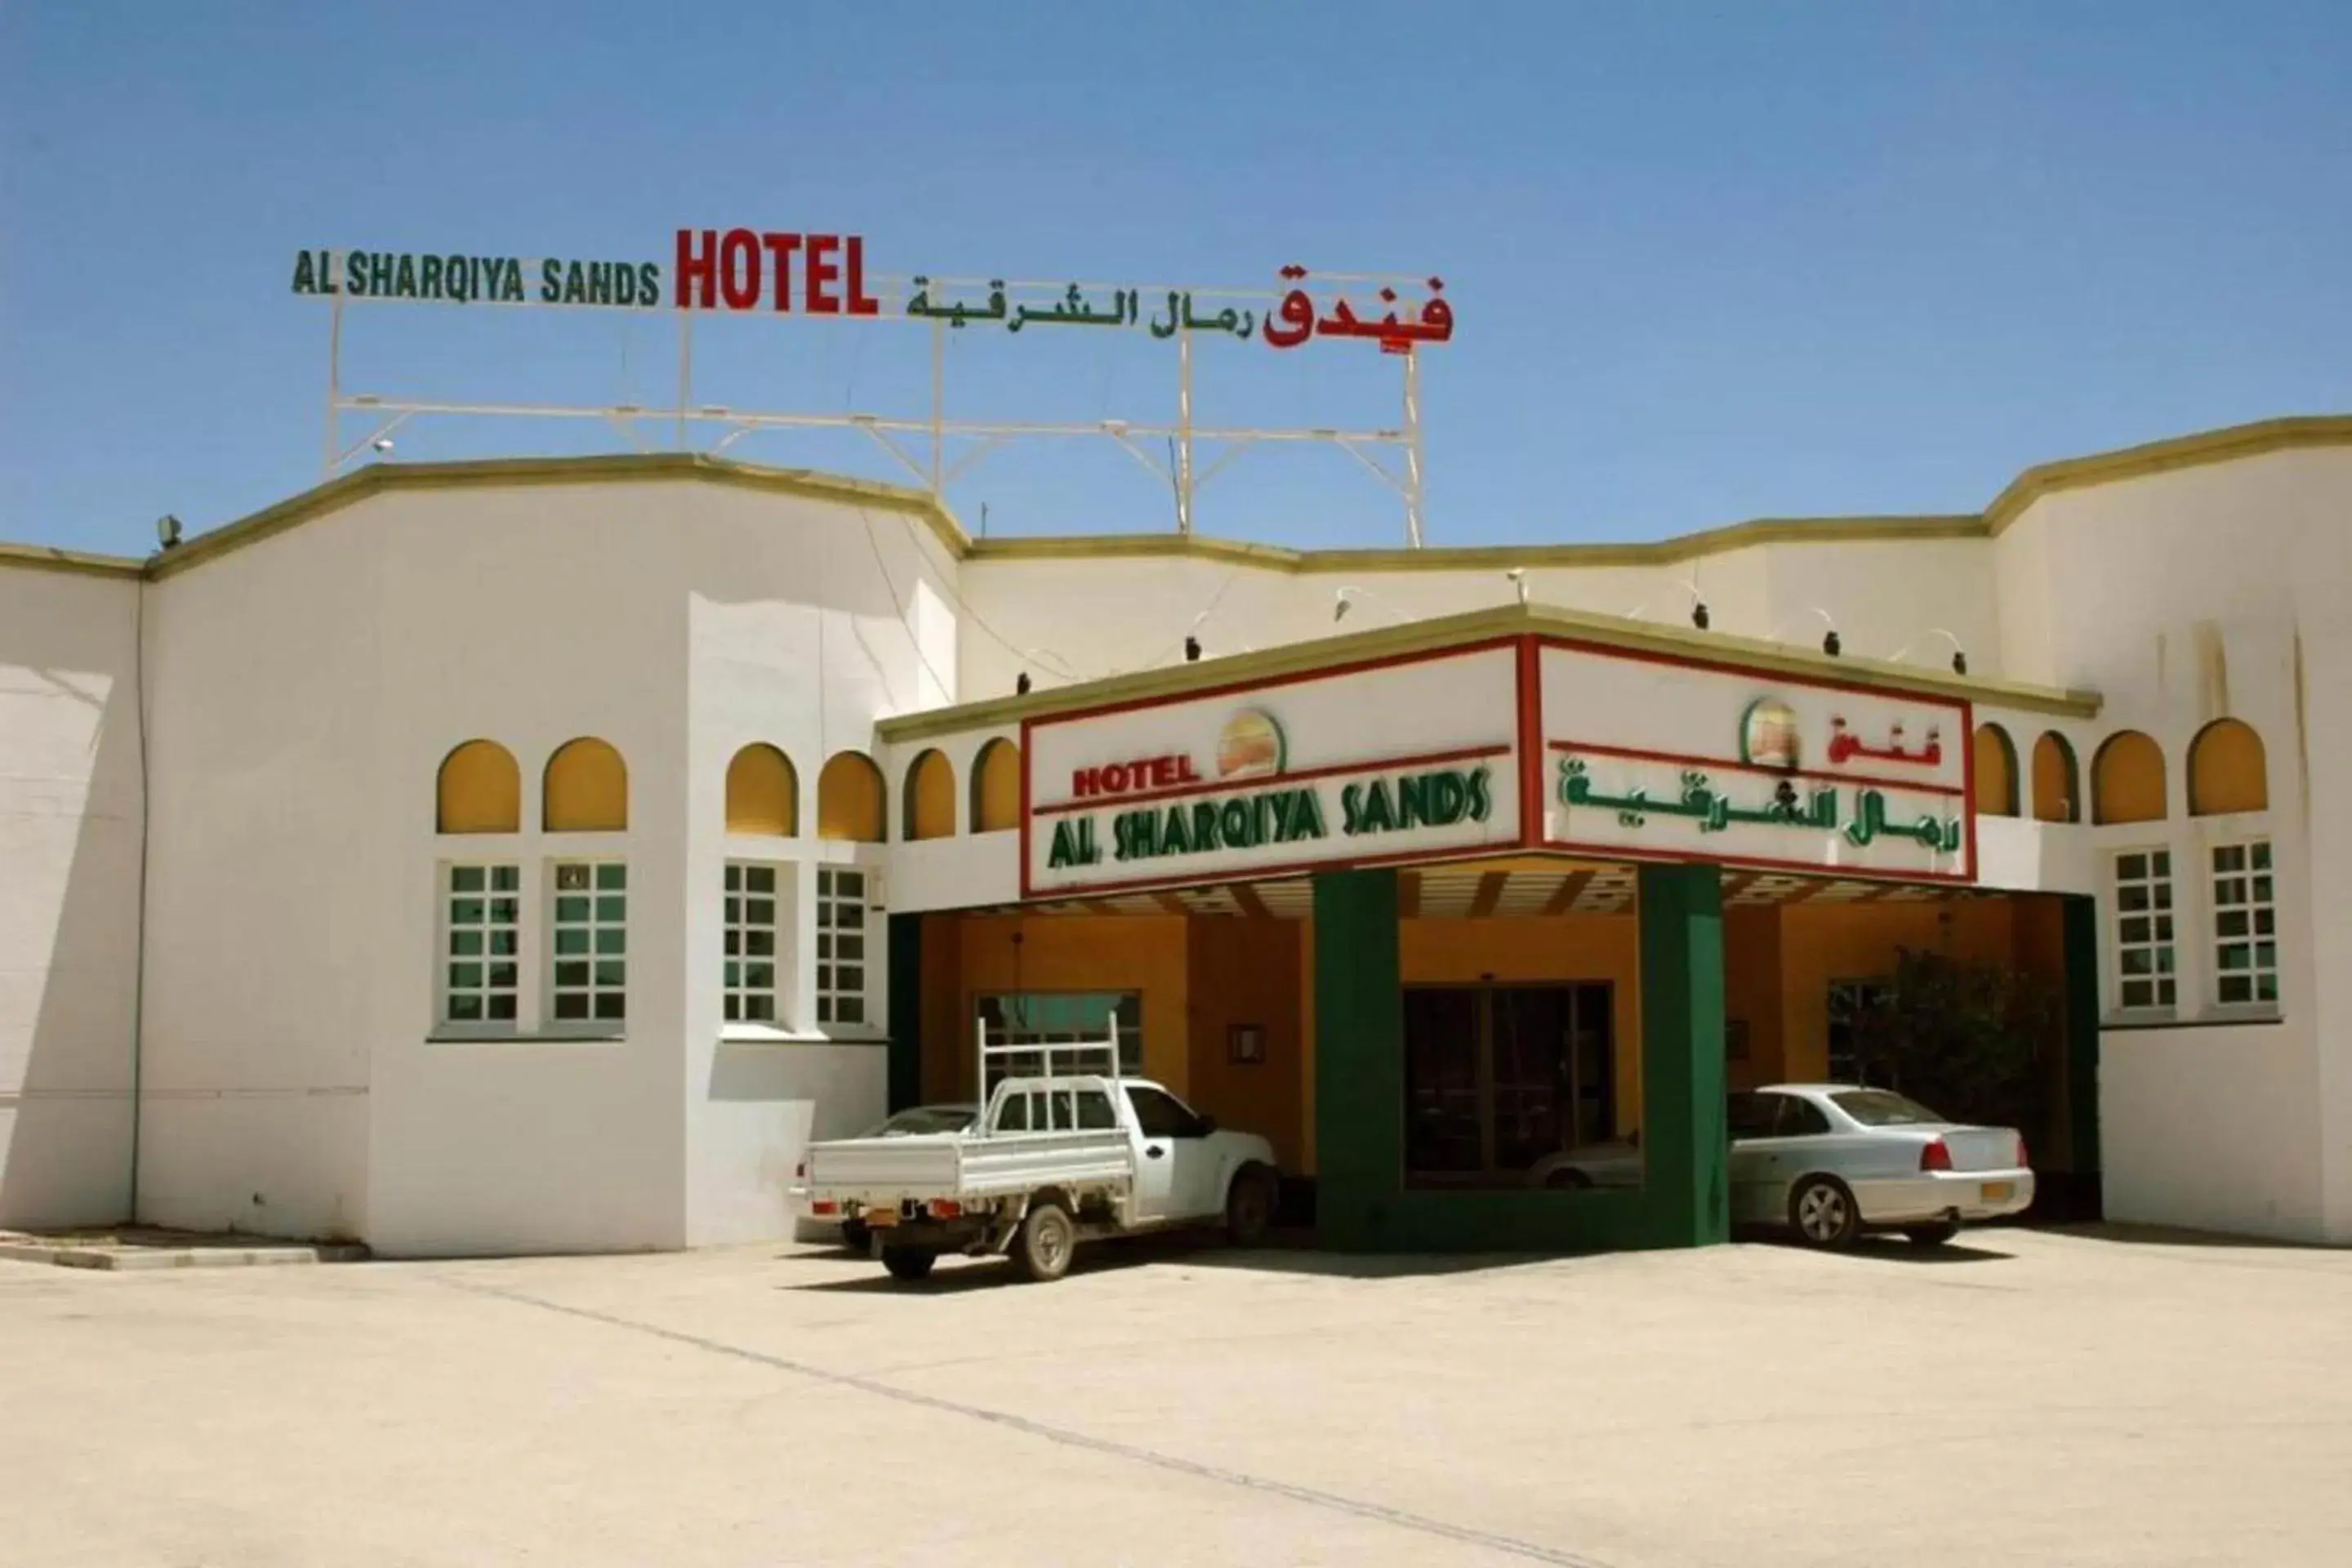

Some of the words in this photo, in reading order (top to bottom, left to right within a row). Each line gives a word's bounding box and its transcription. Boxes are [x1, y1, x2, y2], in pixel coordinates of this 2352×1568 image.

[290, 250, 339, 295] AL
[346, 251, 525, 304] SHARQIYA
[541, 258, 662, 307] SANDS
[675, 228, 880, 315] HOTEL
[906, 275, 1138, 333] الشرقية
[1150, 290, 1254, 340] رمال
[1263, 265, 1454, 353] فندق
[1072, 753, 1200, 797] HOTEL
[1047, 817, 1102, 869] AL
[1113, 788, 1328, 862] SHARQIYA
[1341, 766, 1492, 836] SANDS
[1842, 789, 1960, 853] رمال
